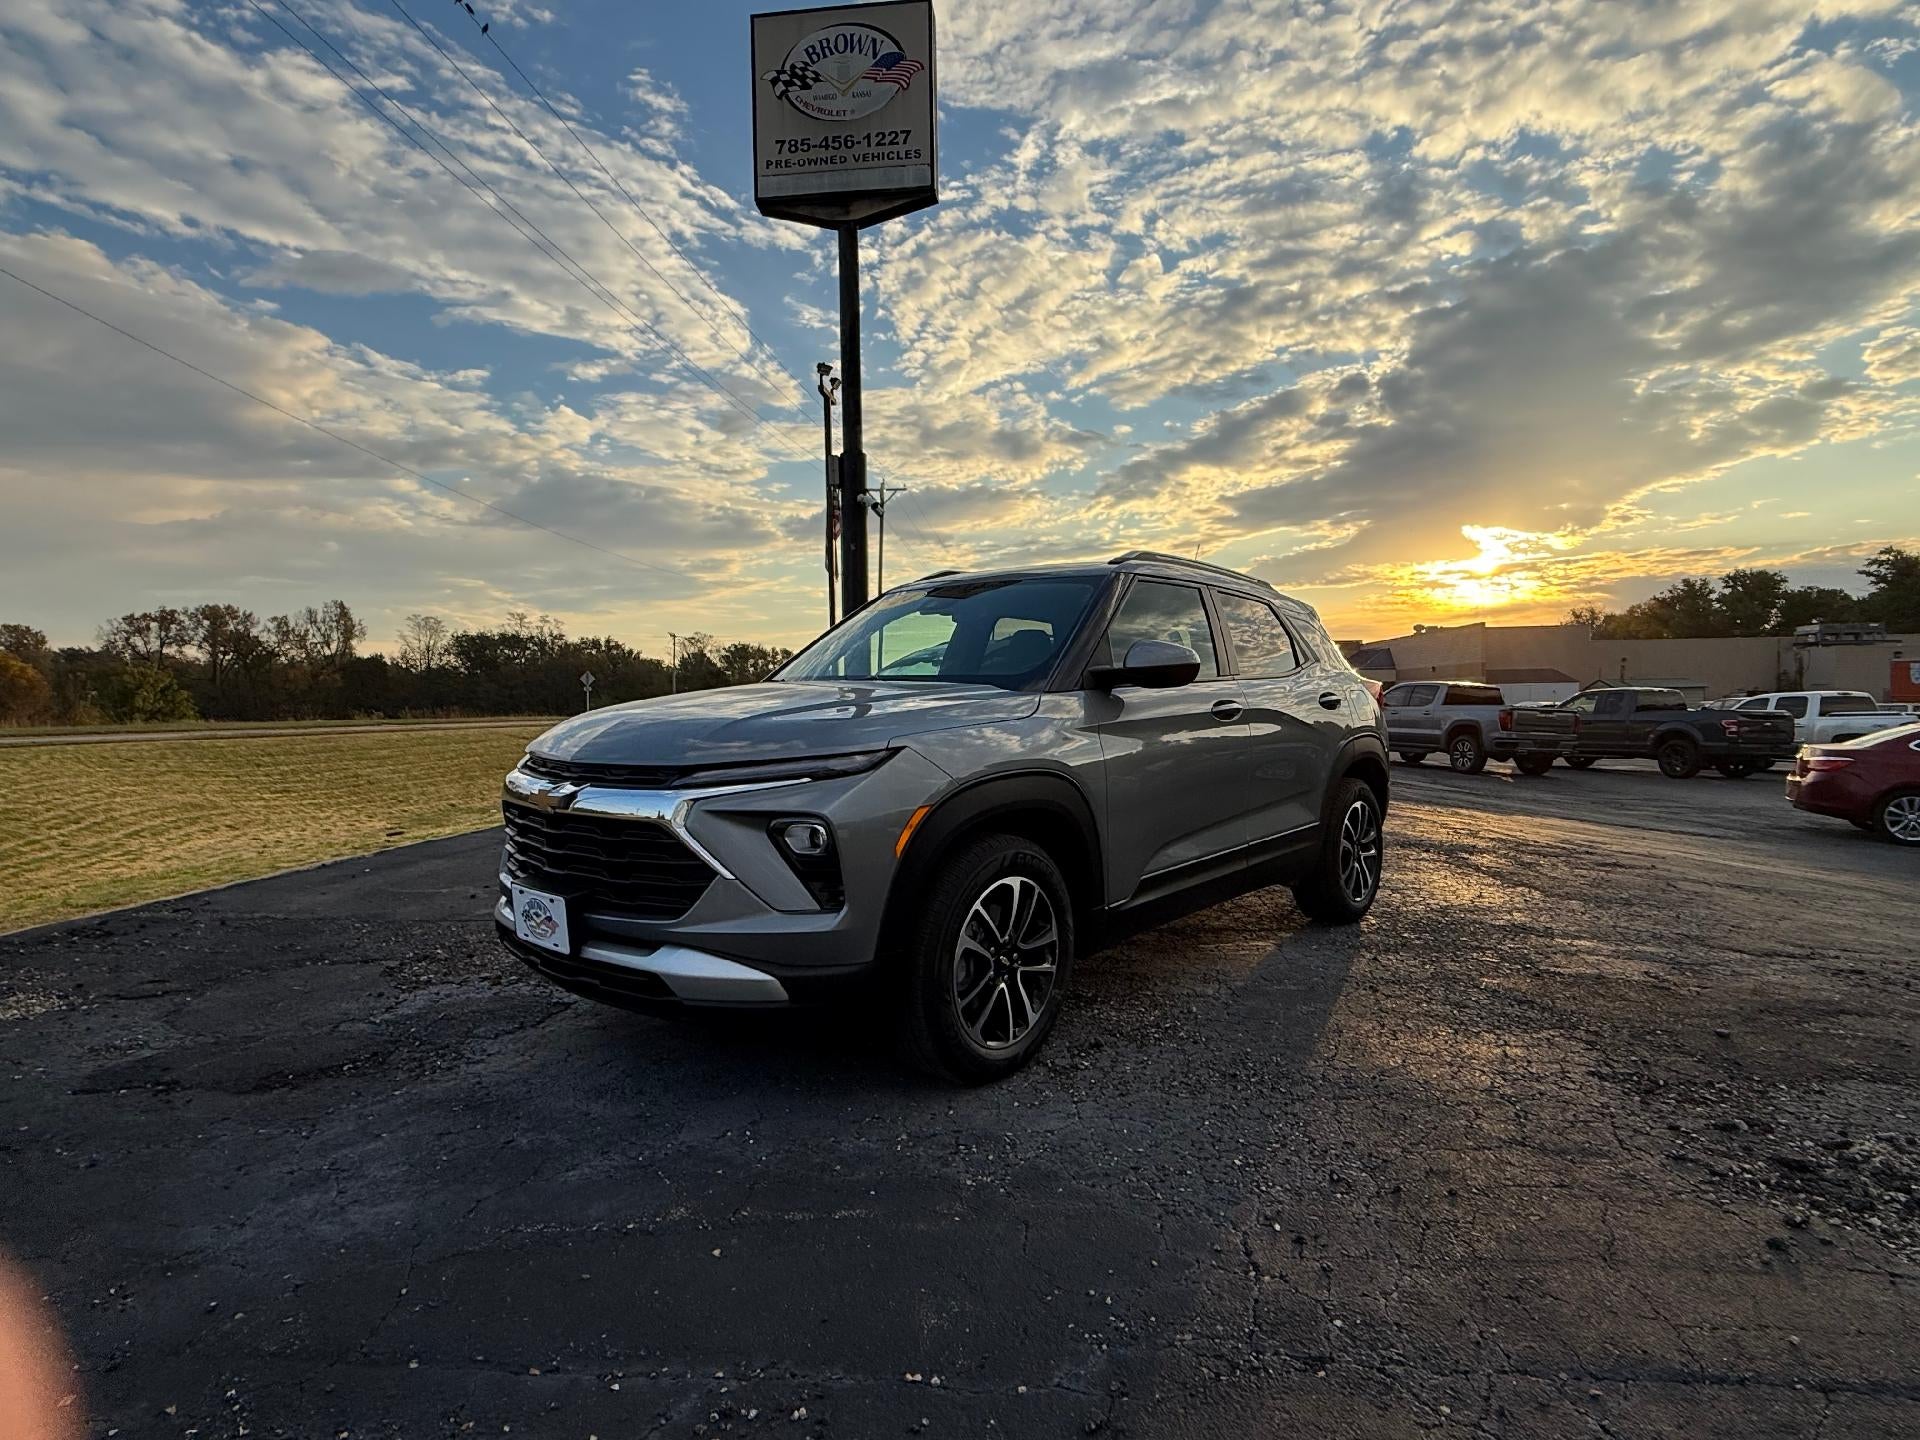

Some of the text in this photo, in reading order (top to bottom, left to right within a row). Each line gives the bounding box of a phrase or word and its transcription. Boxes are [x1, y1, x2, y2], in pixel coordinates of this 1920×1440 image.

[804, 32, 884, 65] BROWN
[795, 95, 848, 117] CHEVROLET
[775, 129, 912, 155] 785-456-1227
[765, 148, 922, 170] PRE-OWNED VEHICLES
